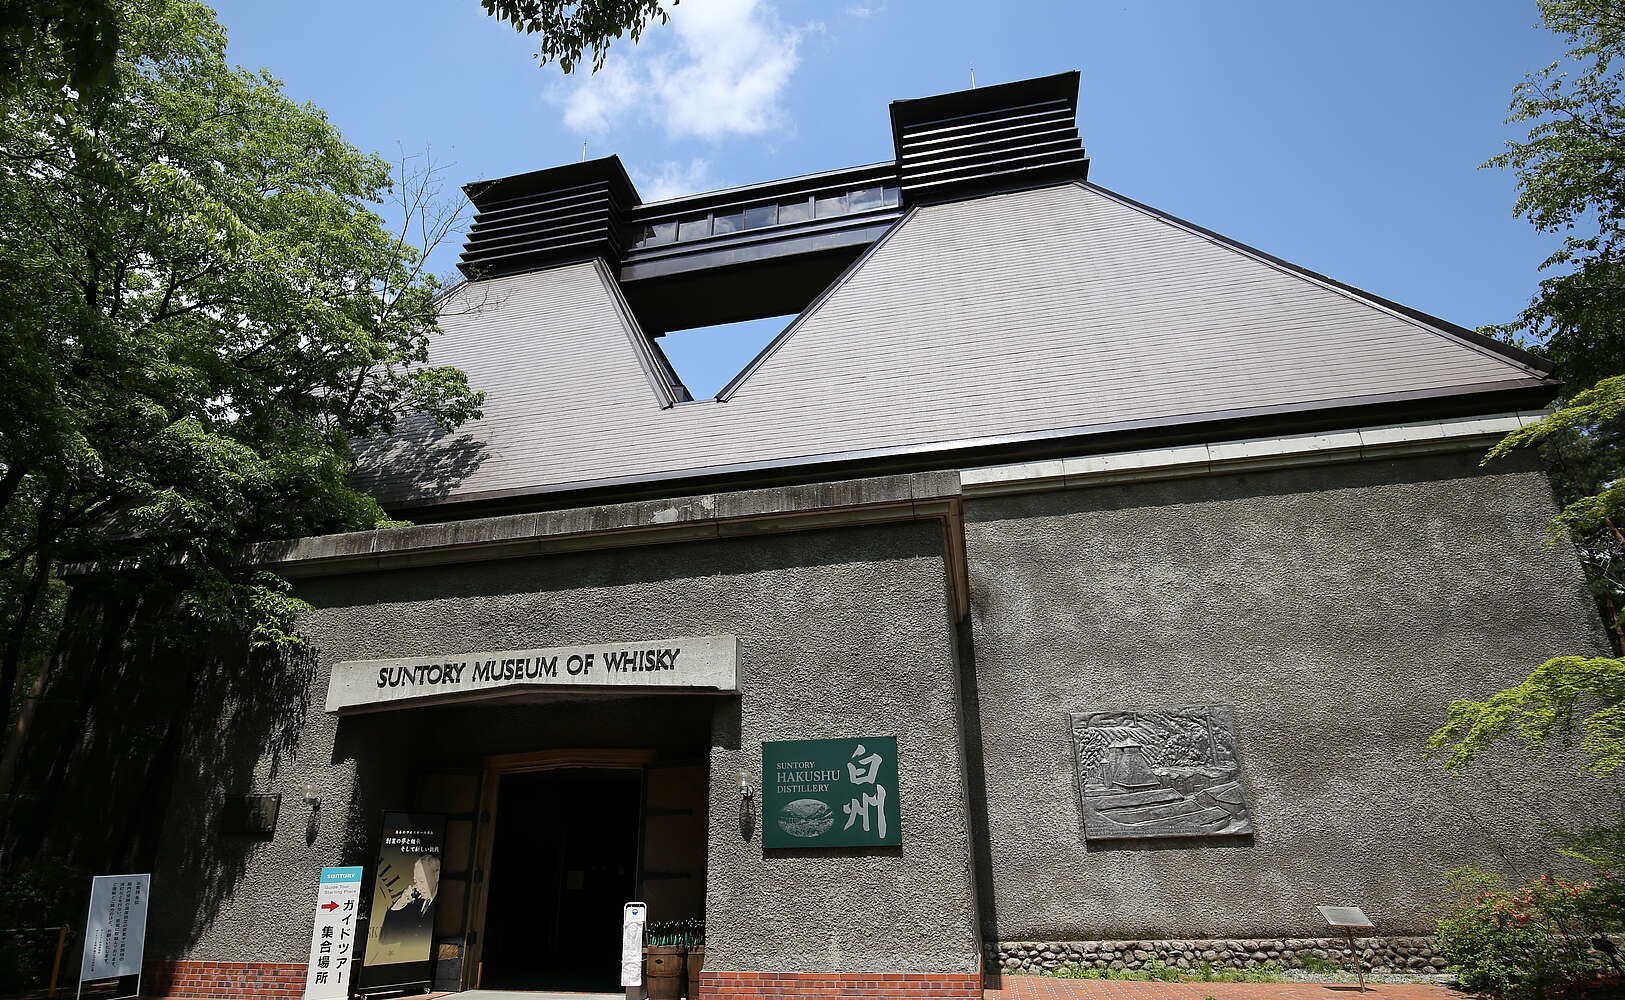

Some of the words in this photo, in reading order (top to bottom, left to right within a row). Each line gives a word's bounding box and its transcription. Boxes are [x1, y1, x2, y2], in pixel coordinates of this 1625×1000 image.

[376, 662, 466, 688] SUNTORY
[472, 656, 558, 682] MUSEUM
[566, 653, 594, 676] OF
[603, 649, 681, 673] WHISKY
[776, 761, 816, 770] SUNTORY
[776, 769, 841, 783] HAKUSHU
[777, 783, 830, 794] DISTILLERY
[842, 744, 887, 839] 白州
[315, 925, 334, 985] 集合場所
[336, 899, 355, 985] ガイドツアー
